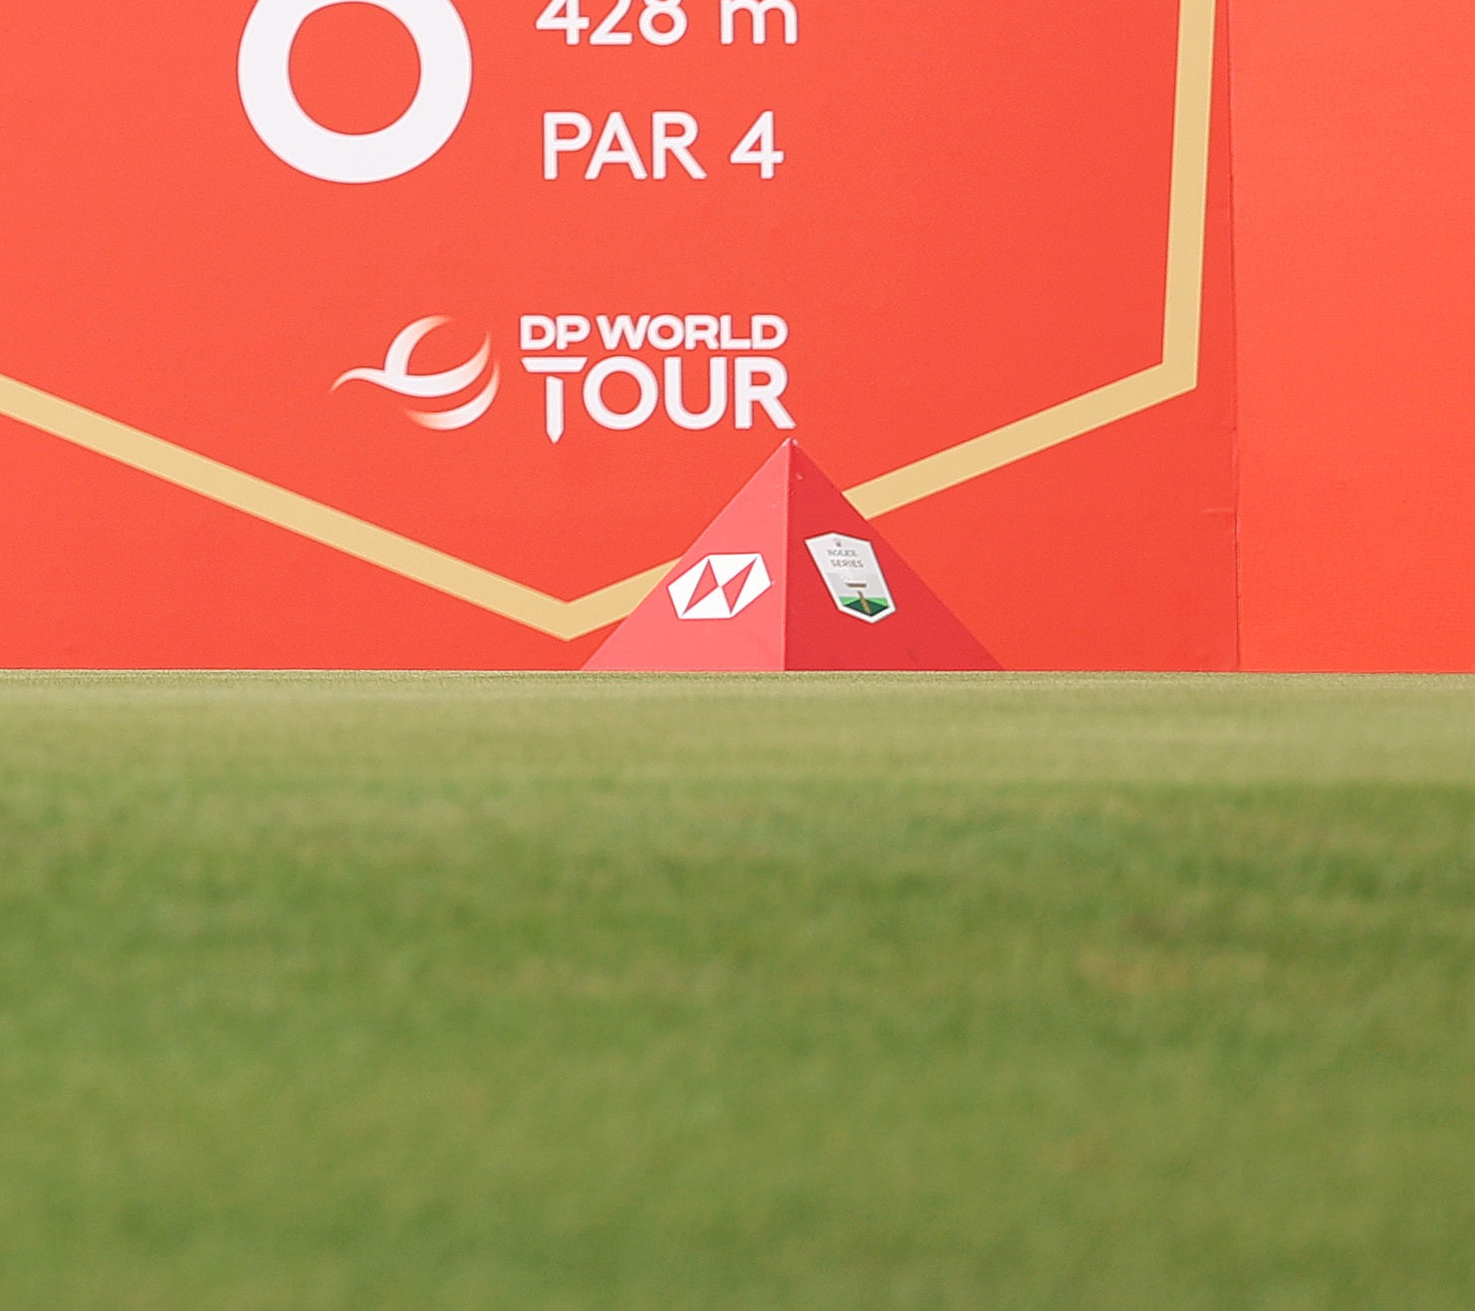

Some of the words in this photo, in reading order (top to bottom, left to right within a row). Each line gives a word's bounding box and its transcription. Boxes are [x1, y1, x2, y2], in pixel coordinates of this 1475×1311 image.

[542, 110, 708, 181] PAR
[729, 109, 785, 180] 4
[519, 314, 592, 351] DP
[595, 313, 789, 351] WORLD
[520, 355, 797, 444] TOUR
